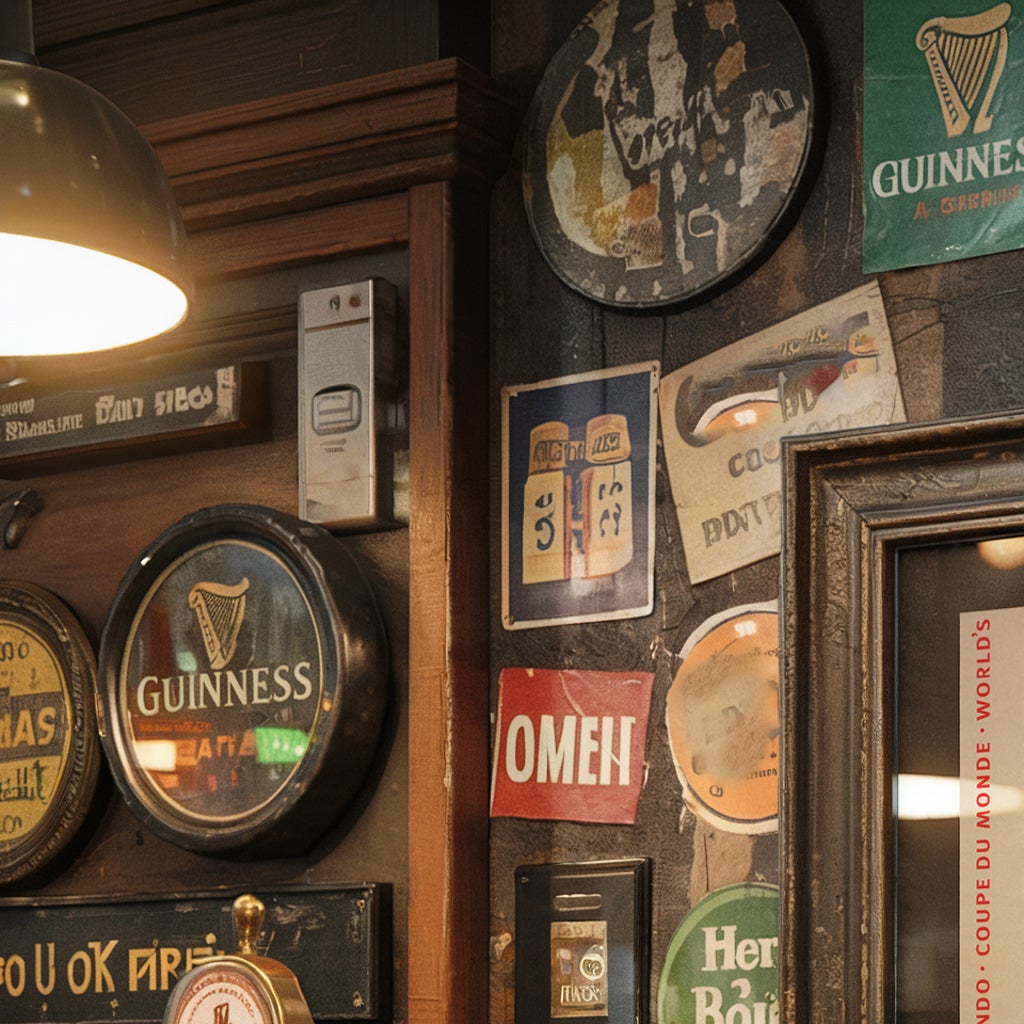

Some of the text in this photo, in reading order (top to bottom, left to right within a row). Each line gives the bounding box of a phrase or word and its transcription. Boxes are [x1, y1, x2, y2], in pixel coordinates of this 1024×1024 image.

[137, 662, 312, 716] GUINNESS
[972, 619, 991, 721] WORLD'S
[976, 742, 990, 828] MONDE
[976, 839, 990, 870] DU
[976, 879, 990, 956] COUPE
